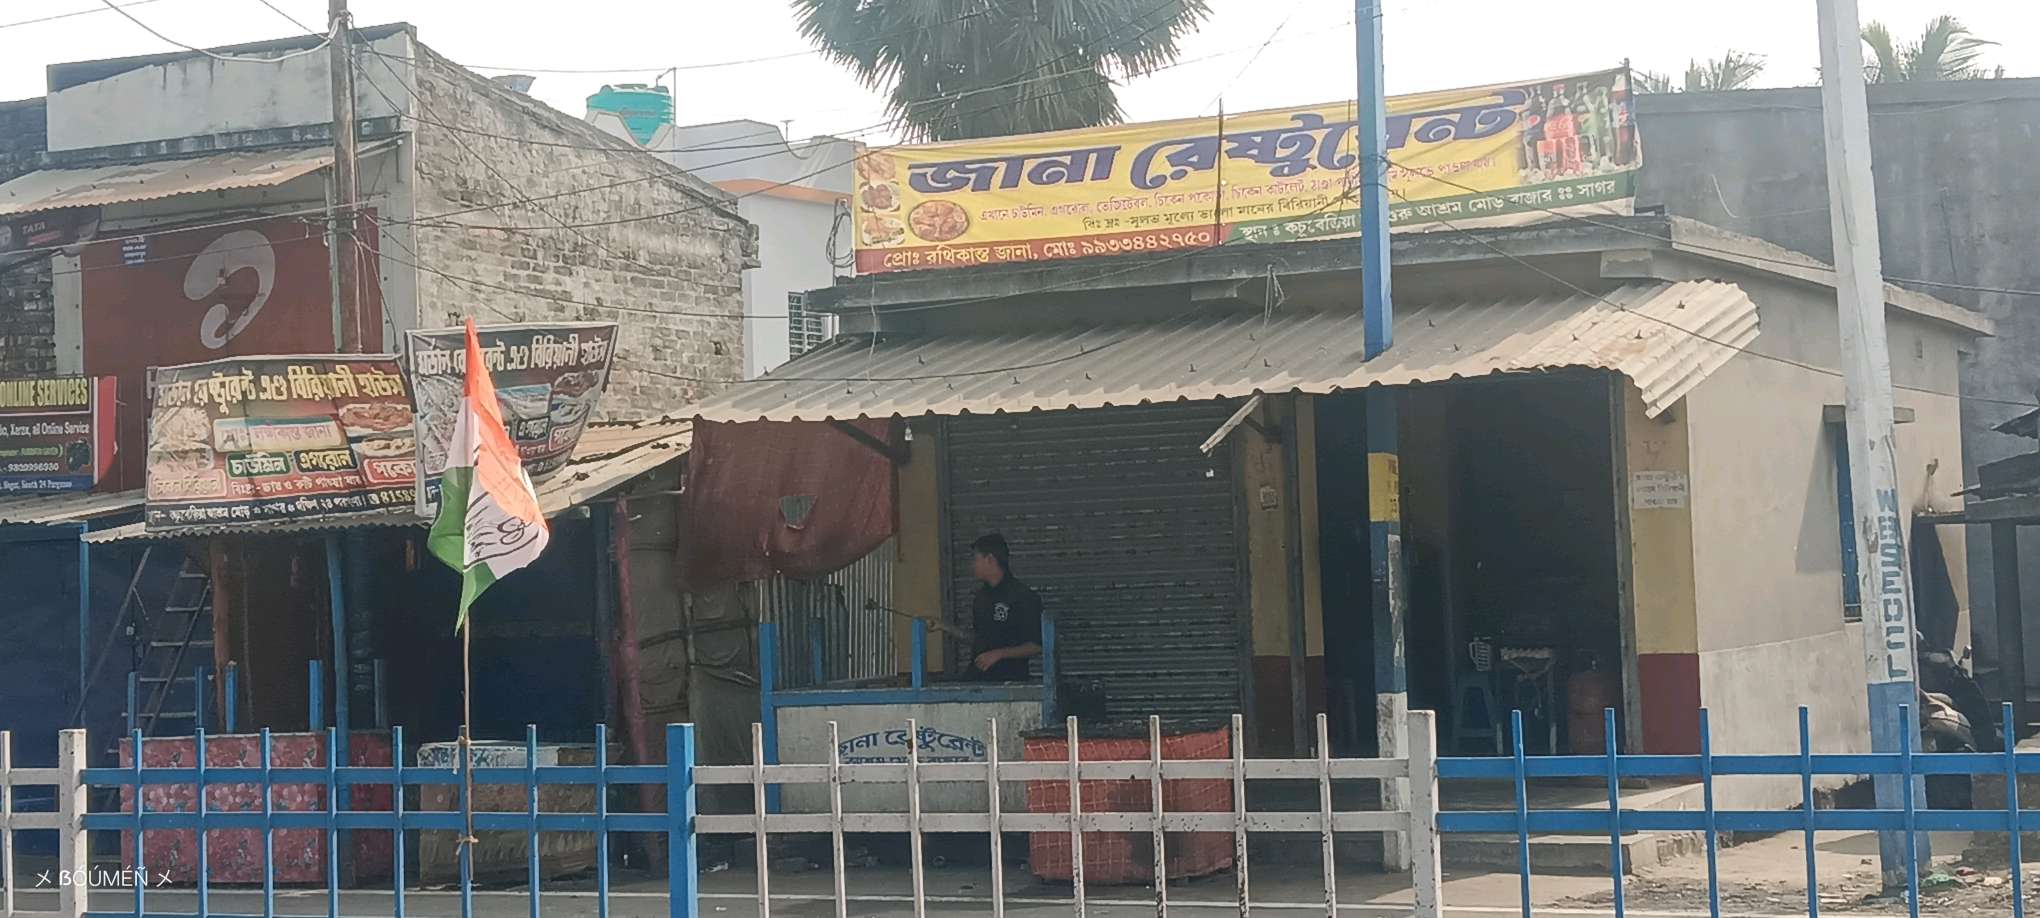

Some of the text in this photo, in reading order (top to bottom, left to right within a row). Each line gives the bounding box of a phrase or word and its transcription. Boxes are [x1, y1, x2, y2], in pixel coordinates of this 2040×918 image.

[906, 145, 1122, 194] জানা
[1416, 200, 1462, 217] আশ্রম
[1577, 180, 1616, 198] সাগর
[21, 221, 46, 235] TATA
[883, 251, 920, 268] প্রোঃ
[1043, 241, 1077, 259] মোঃ
[1082, 230, 1211, 256] ৯৯৩৩৪৪২৭৫০
[0, 378, 88, 408] ONLINE SERVICES
[355, 366, 405, 398] হাউস
[42, 421, 63, 435] Online
[65, 421, 90, 435] Service
[230, 453, 287, 475] চাউমিন
[299, 450, 354, 470] এগরোল
